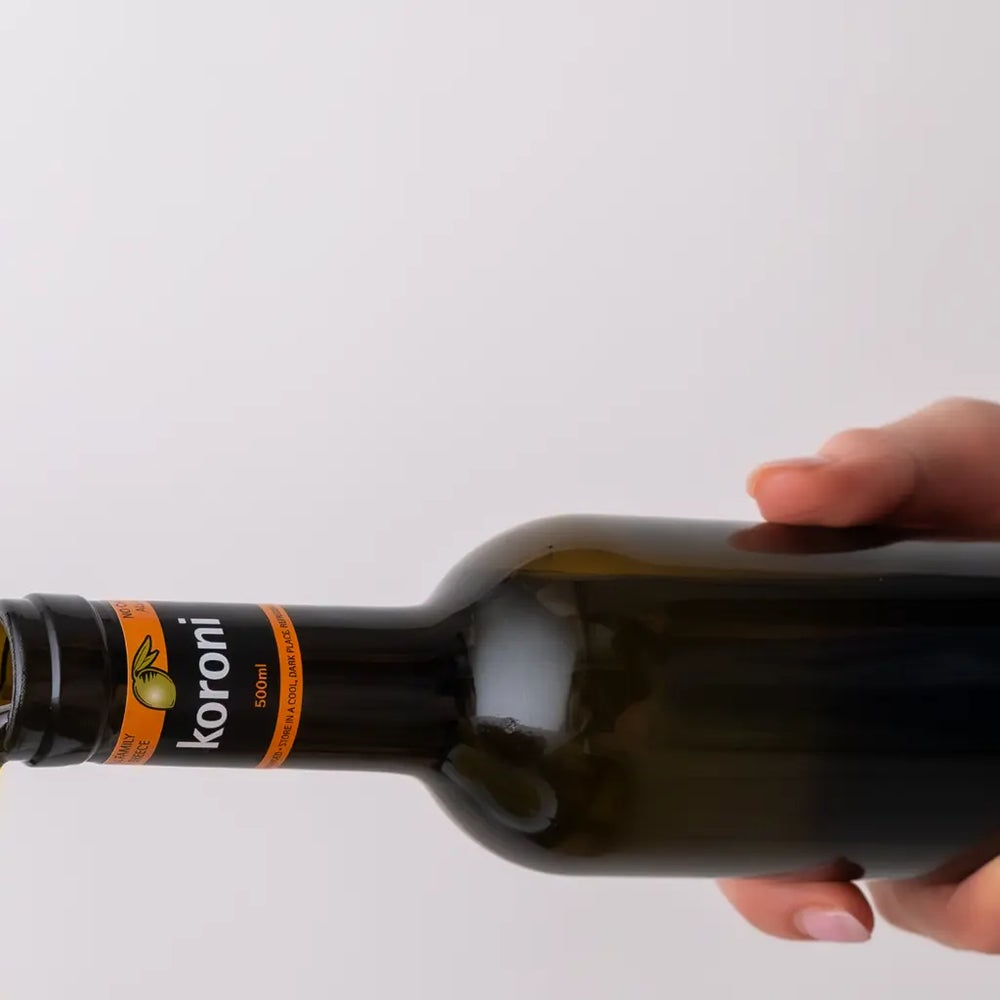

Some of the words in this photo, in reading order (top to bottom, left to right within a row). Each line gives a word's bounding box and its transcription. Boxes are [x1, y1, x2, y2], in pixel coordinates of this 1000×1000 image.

[287, 655, 297, 678] DARK
[175, 617, 231, 749] koroni
[254, 663, 268, 708] 500ml
[288, 679, 298, 705] COOL,
[285, 715, 294, 724] IN
[115, 733, 136, 759] FAMILY
[278, 724, 293, 747] STORE
